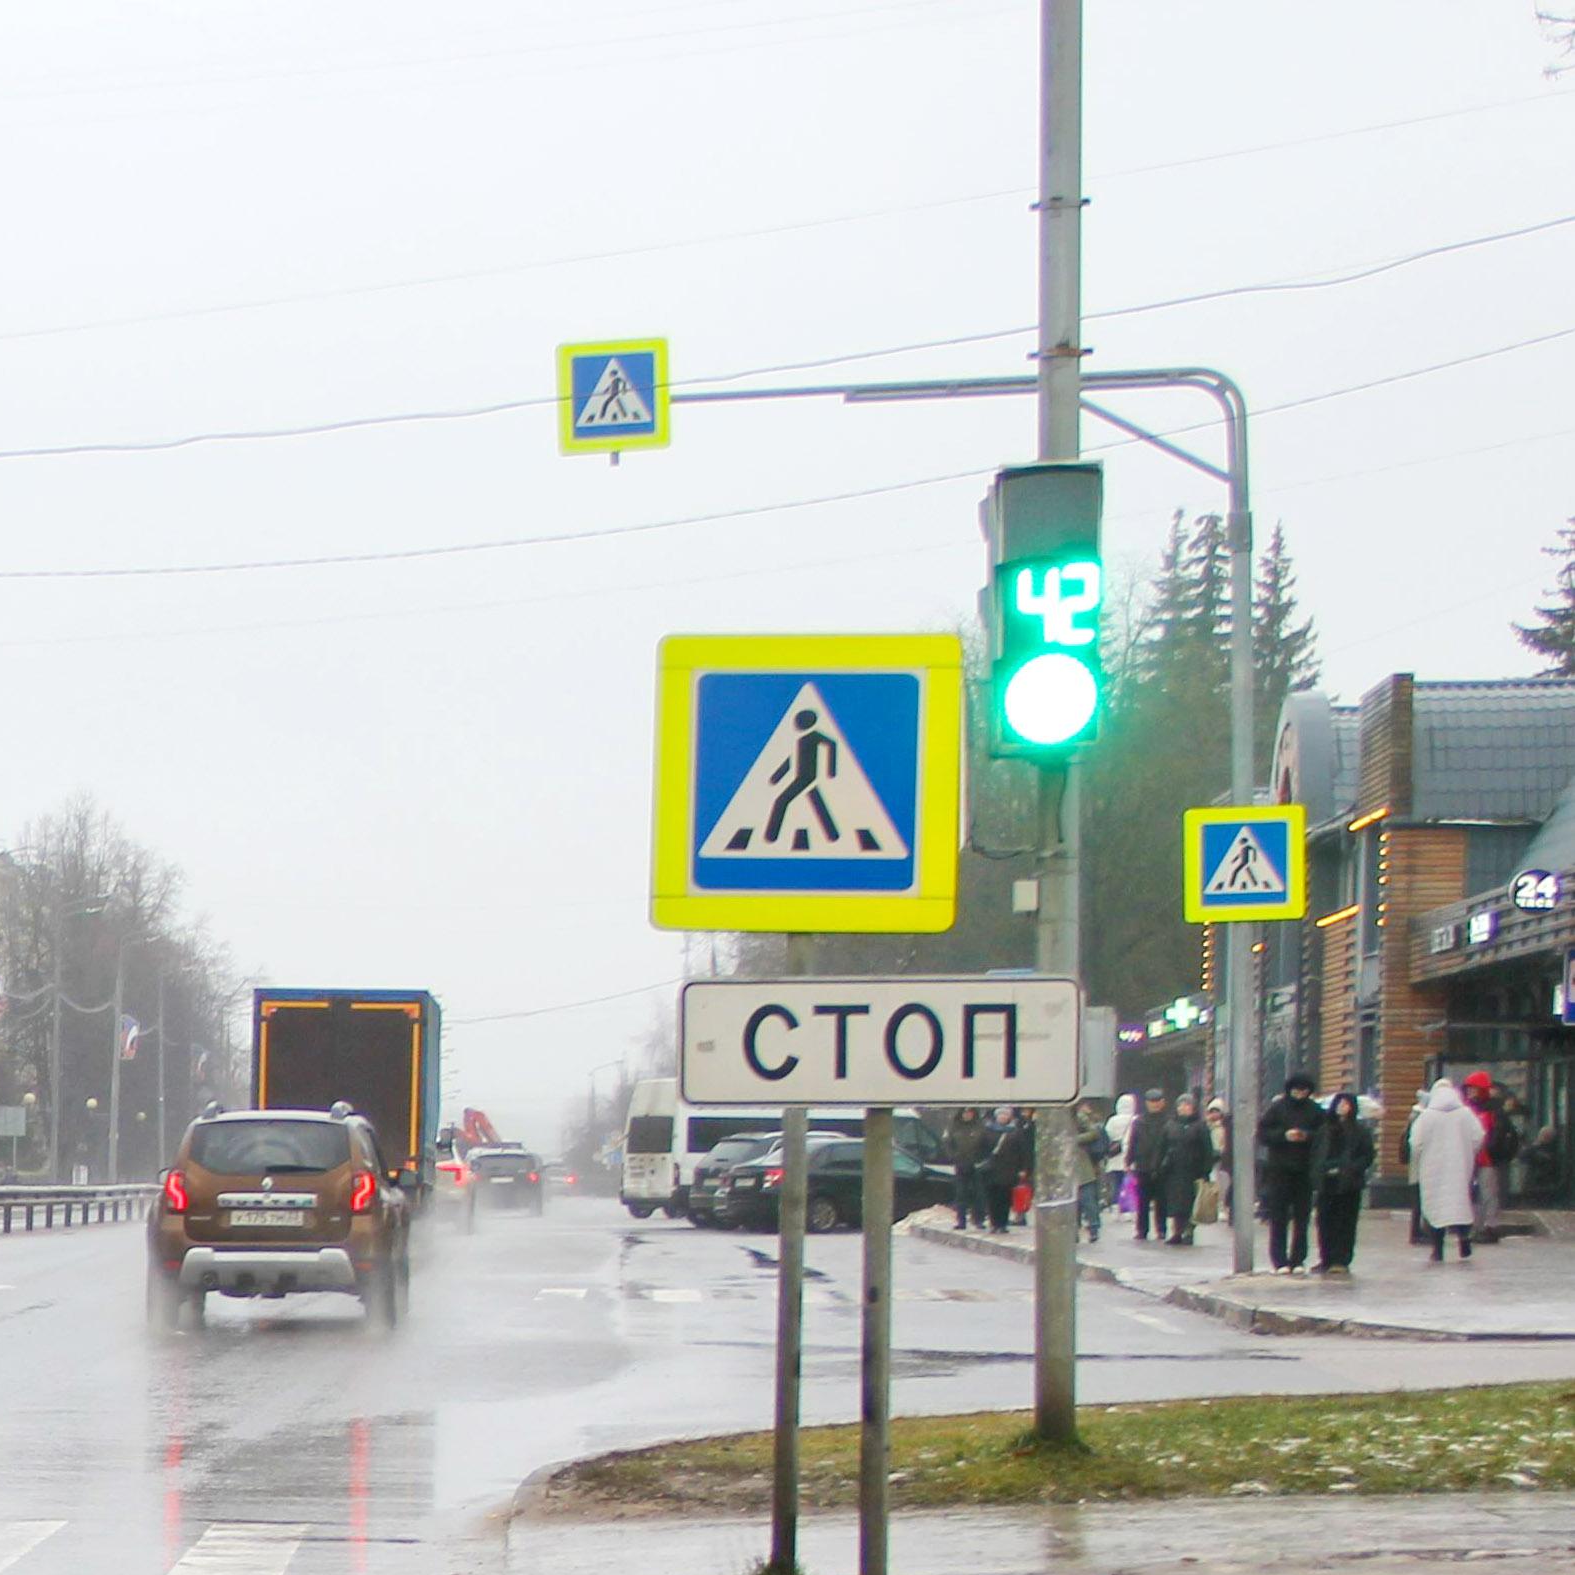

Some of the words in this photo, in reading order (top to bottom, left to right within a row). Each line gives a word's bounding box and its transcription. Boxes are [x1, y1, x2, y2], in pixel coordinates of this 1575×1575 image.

[1017, 561, 1101, 646] 42
[1515, 874, 1558, 899] 24
[742, 1002, 1019, 1081] СТОП
